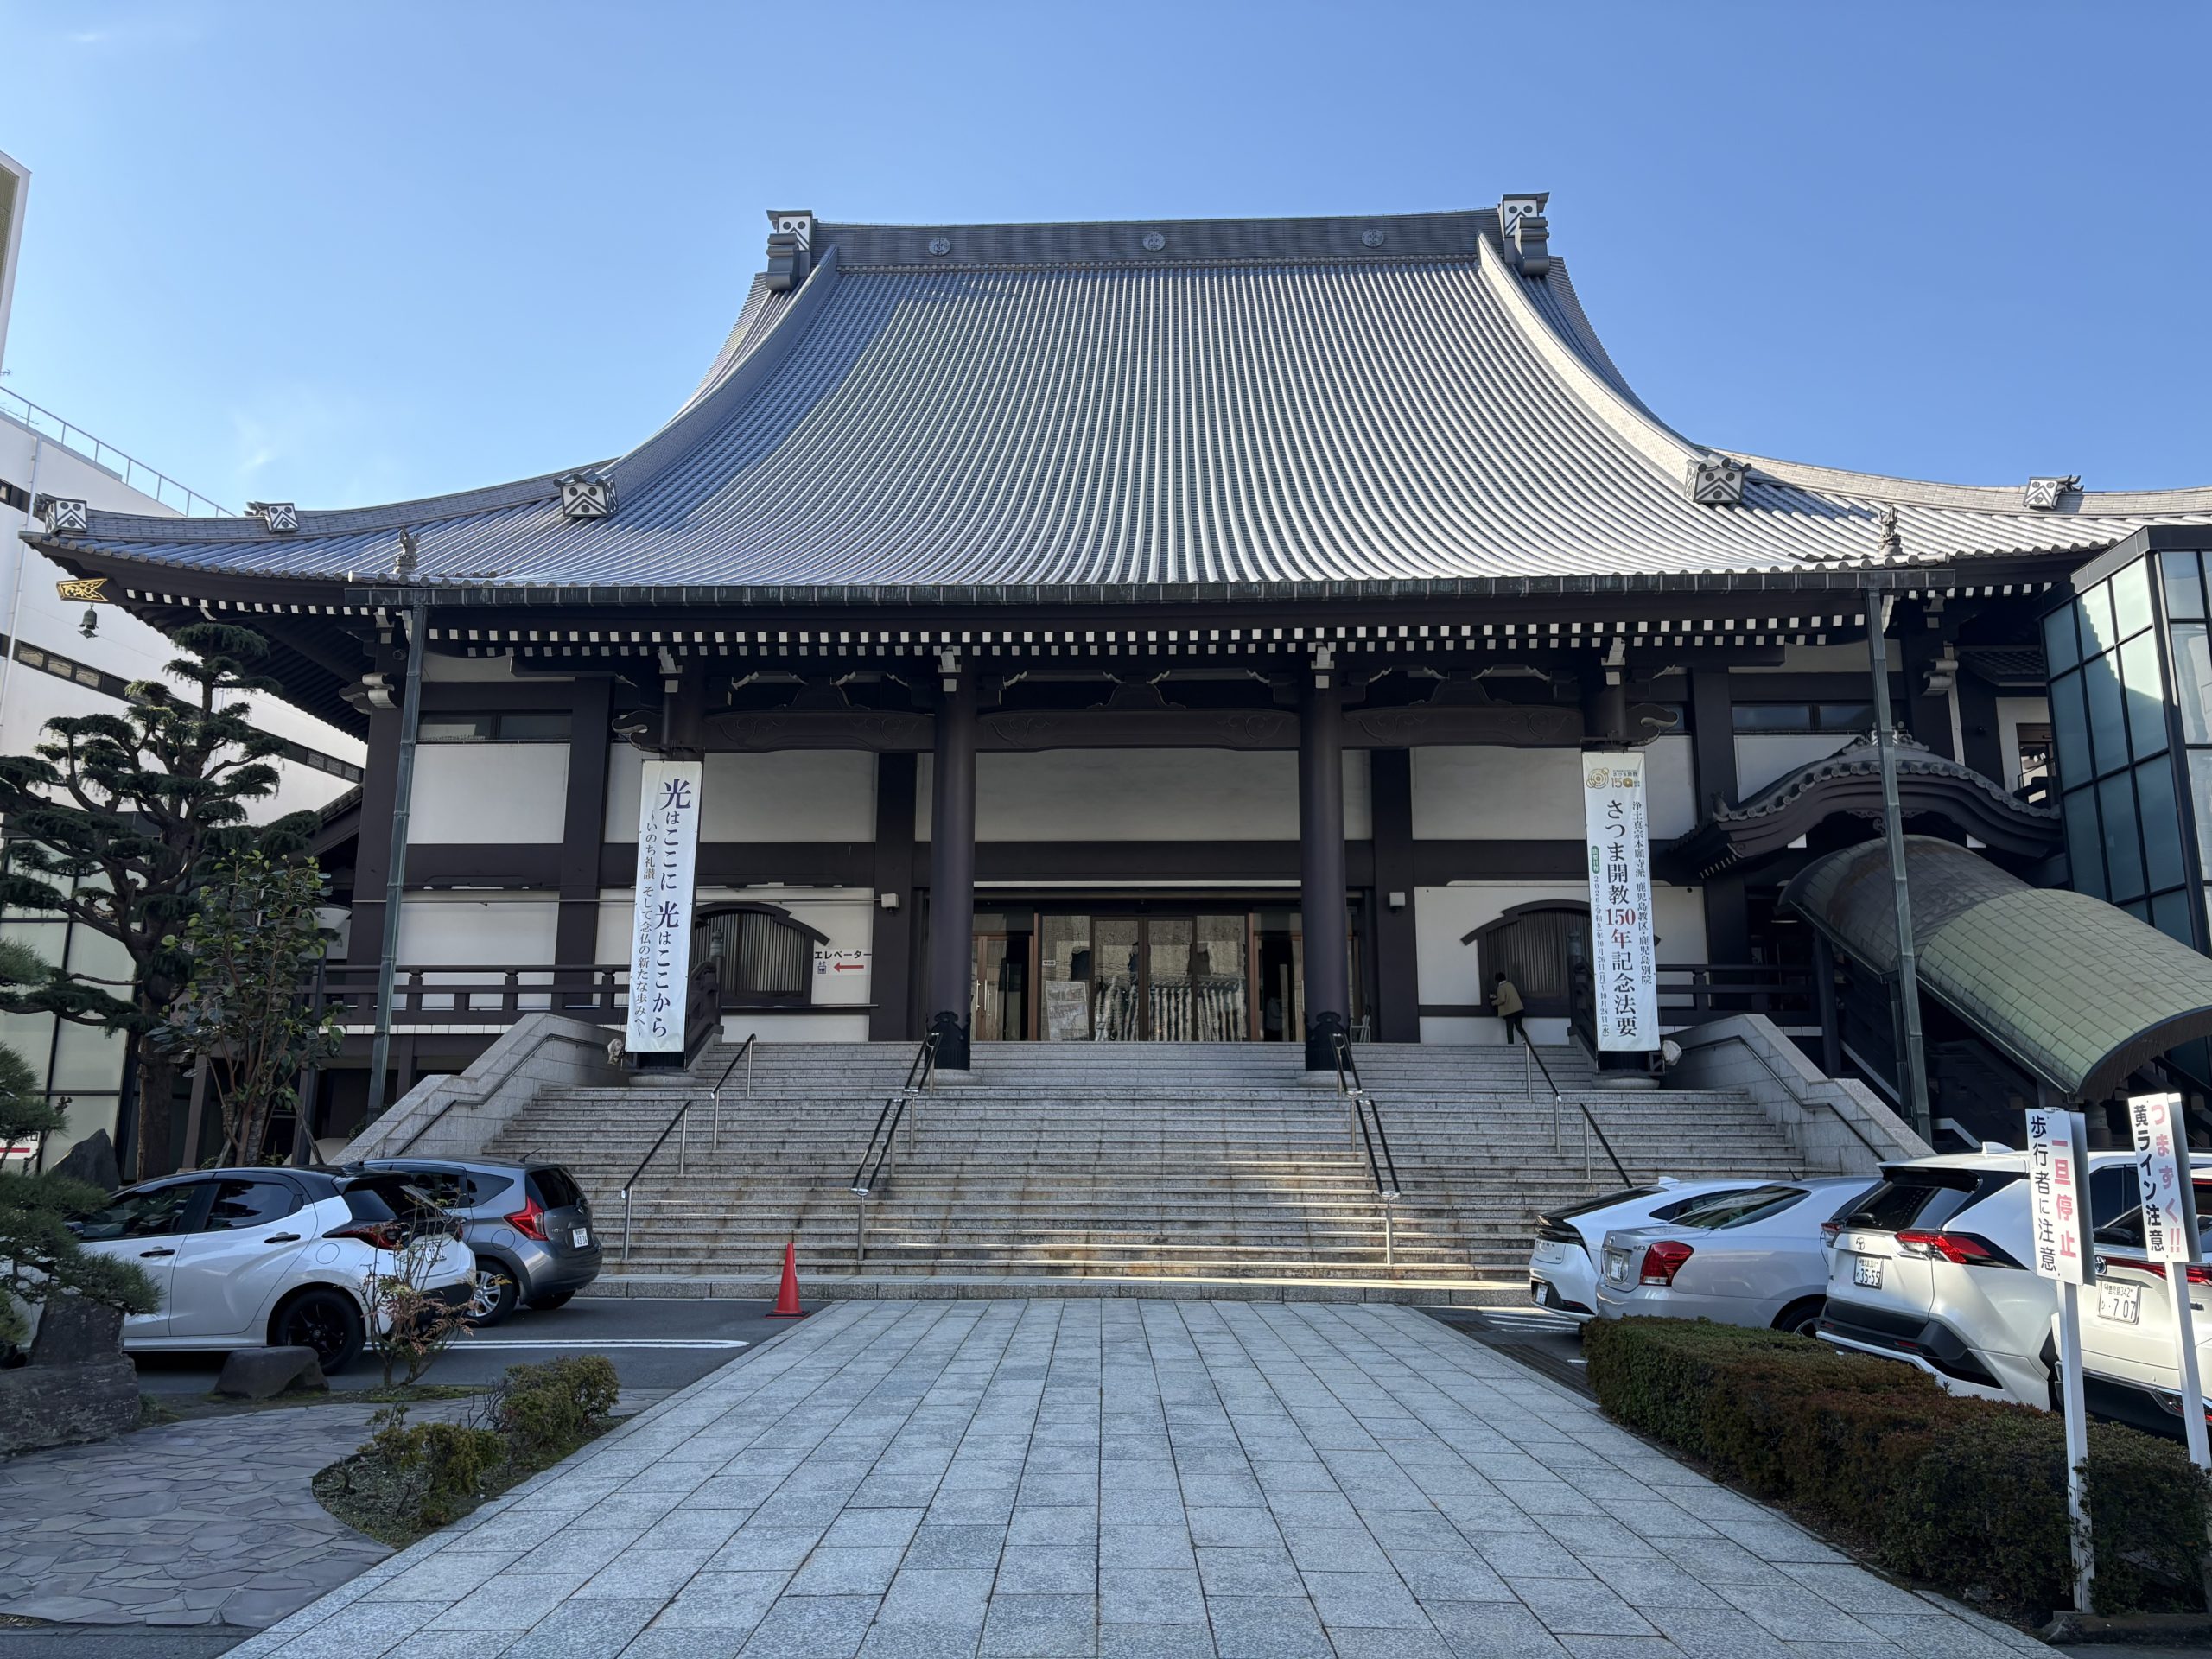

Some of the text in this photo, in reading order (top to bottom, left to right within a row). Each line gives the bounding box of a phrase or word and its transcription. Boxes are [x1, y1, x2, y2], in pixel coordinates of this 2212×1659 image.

[1632, 800, 1646, 878] 浄土真宗本願寺派
[652, 779, 691, 1037] 光はここに 光はここから
[814, 950, 872, 959] エレベーター
[1605, 798, 1638, 1037] さつま開教150年記念法要
[1636, 882, 1652, 985] 鹿児島教区・鹿児島別院
[2031, 1115, 2056, 1272] 歩行者に注意
[2051, 1139, 2076, 1258] 一旦停止
[2133, 1104, 2164, 1252] 黄ライン注意
